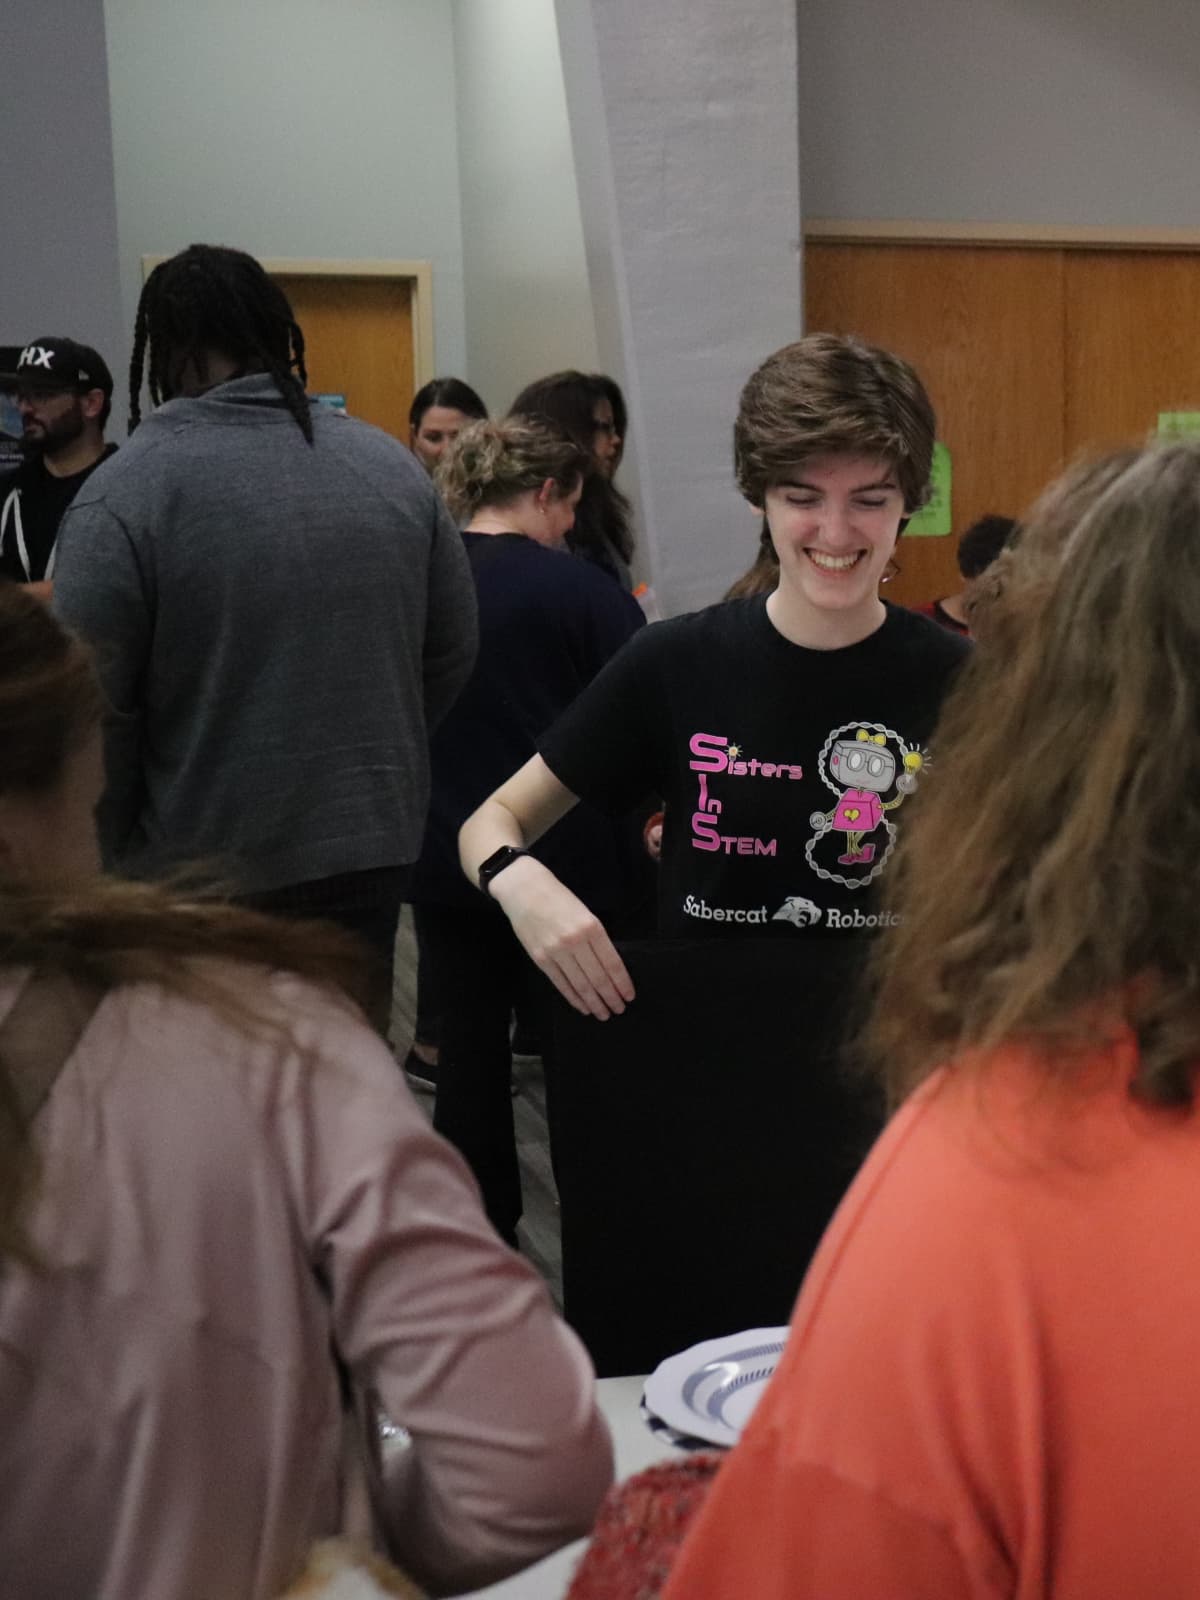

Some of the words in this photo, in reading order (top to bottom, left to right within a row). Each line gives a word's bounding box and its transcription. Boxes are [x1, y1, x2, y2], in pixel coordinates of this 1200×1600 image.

[689, 732, 803, 780] Sisters
[698, 773, 722, 814] In
[691, 811, 777, 856] STEM
[683, 895, 768, 924] Sabercat
[825, 908, 905, 928] Robotic
